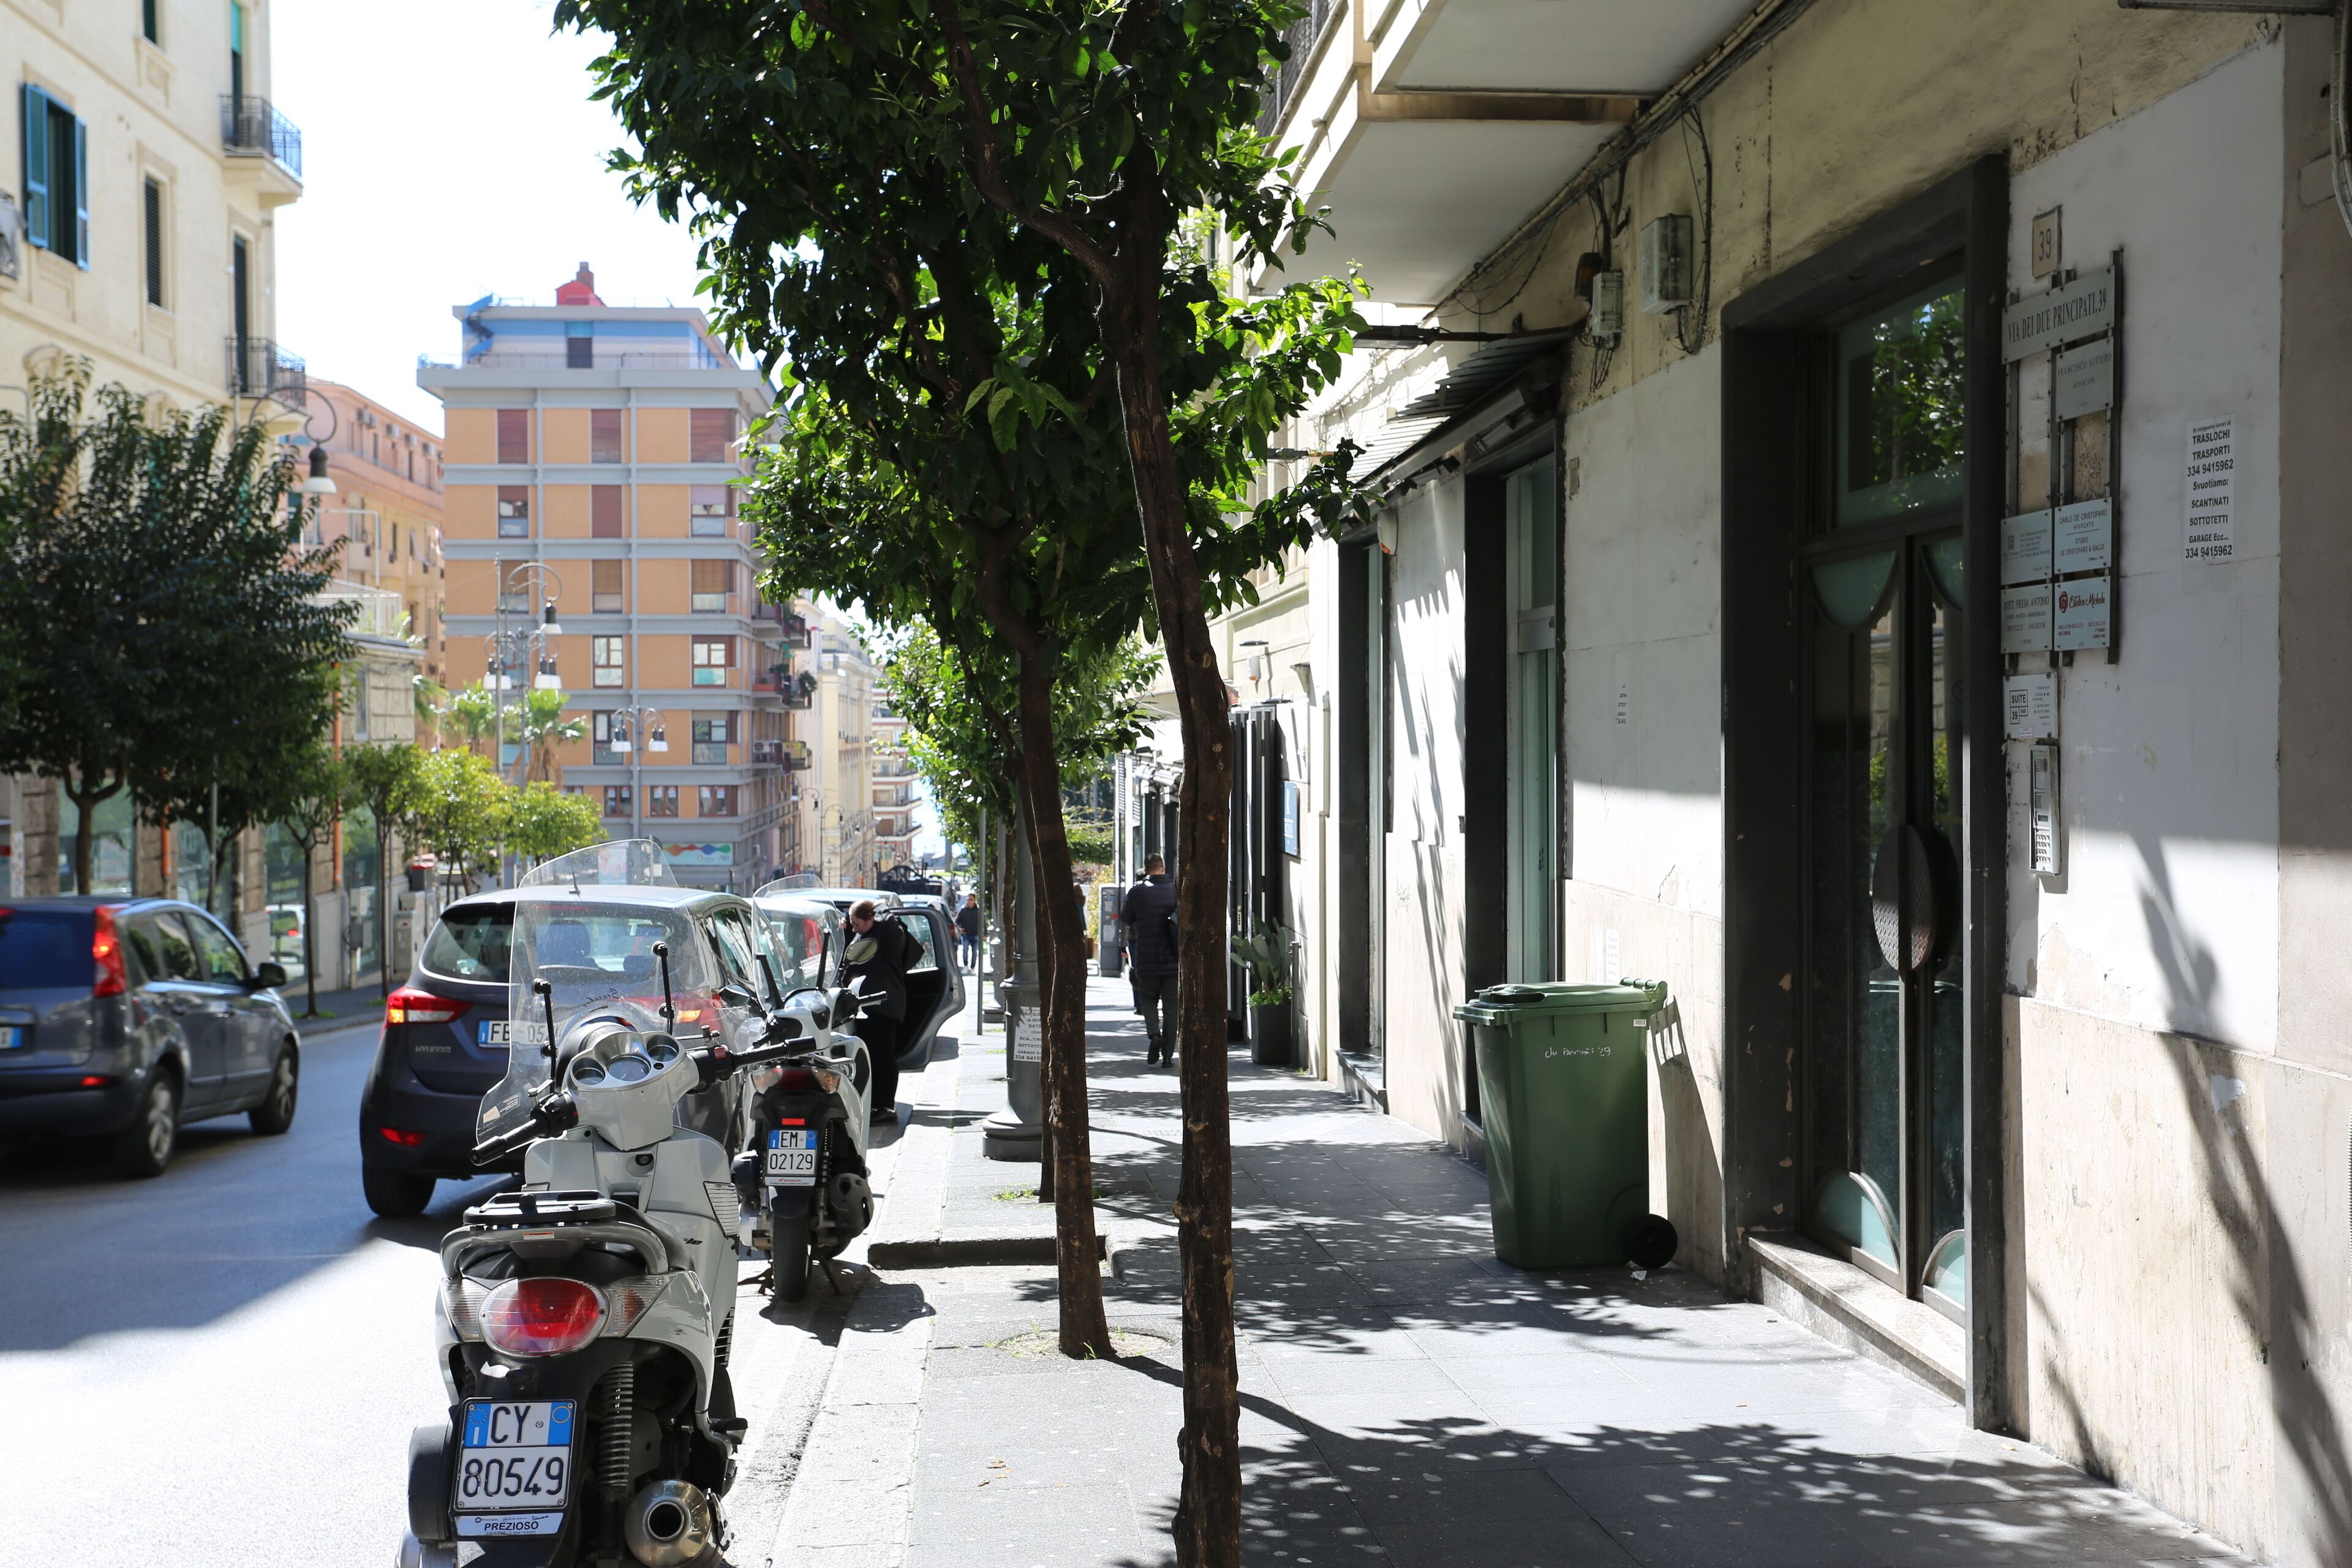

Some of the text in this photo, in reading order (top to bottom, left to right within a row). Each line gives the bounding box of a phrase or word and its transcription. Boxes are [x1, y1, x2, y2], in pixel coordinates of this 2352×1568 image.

[2039, 228, 2052, 262] 39
[2008, 322, 2020, 343] VIA
[2022, 316, 2034, 339] DEI
[2037, 309, 2051, 334] DUE
[2057, 352, 2112, 377] FRANCESCO AUFIERO
[2192, 429, 2230, 445] TRASLOCHI
[2192, 445, 2230, 461] TRASPORTI
[2187, 458, 2234, 477] 334 9415962
[2193, 478, 2229, 491] Svuotiamo:
[2191, 496, 2229, 508] SCANTINATI
[2059, 515, 2073, 524] CARLO
[2081, 509, 2108, 520] CRISTOFARO
[2189, 514, 2228, 526] SOTTOTETTI
[2188, 532, 2229, 544] GARAGE Ecc...
[2066, 546, 2088, 556] CRISTOFARO
[2185, 544, 2233, 559] 334 9415962
[2016, 598, 2029, 609] FRESA
[2030, 596, 2049, 607] ANTONIO
[2011, 694, 2026, 704] SUITE
[2011, 710, 2018, 720] 39
[415, 1045, 451, 1054] HYUNDAI
[780, 1131, 798, 1148] EM
[769, 1153, 813, 1170] 02129
[491, 1405, 531, 1444] CY
[462, 1457, 564, 1498] 80549
[484, 1521, 539, 1531] PREZIOSO
